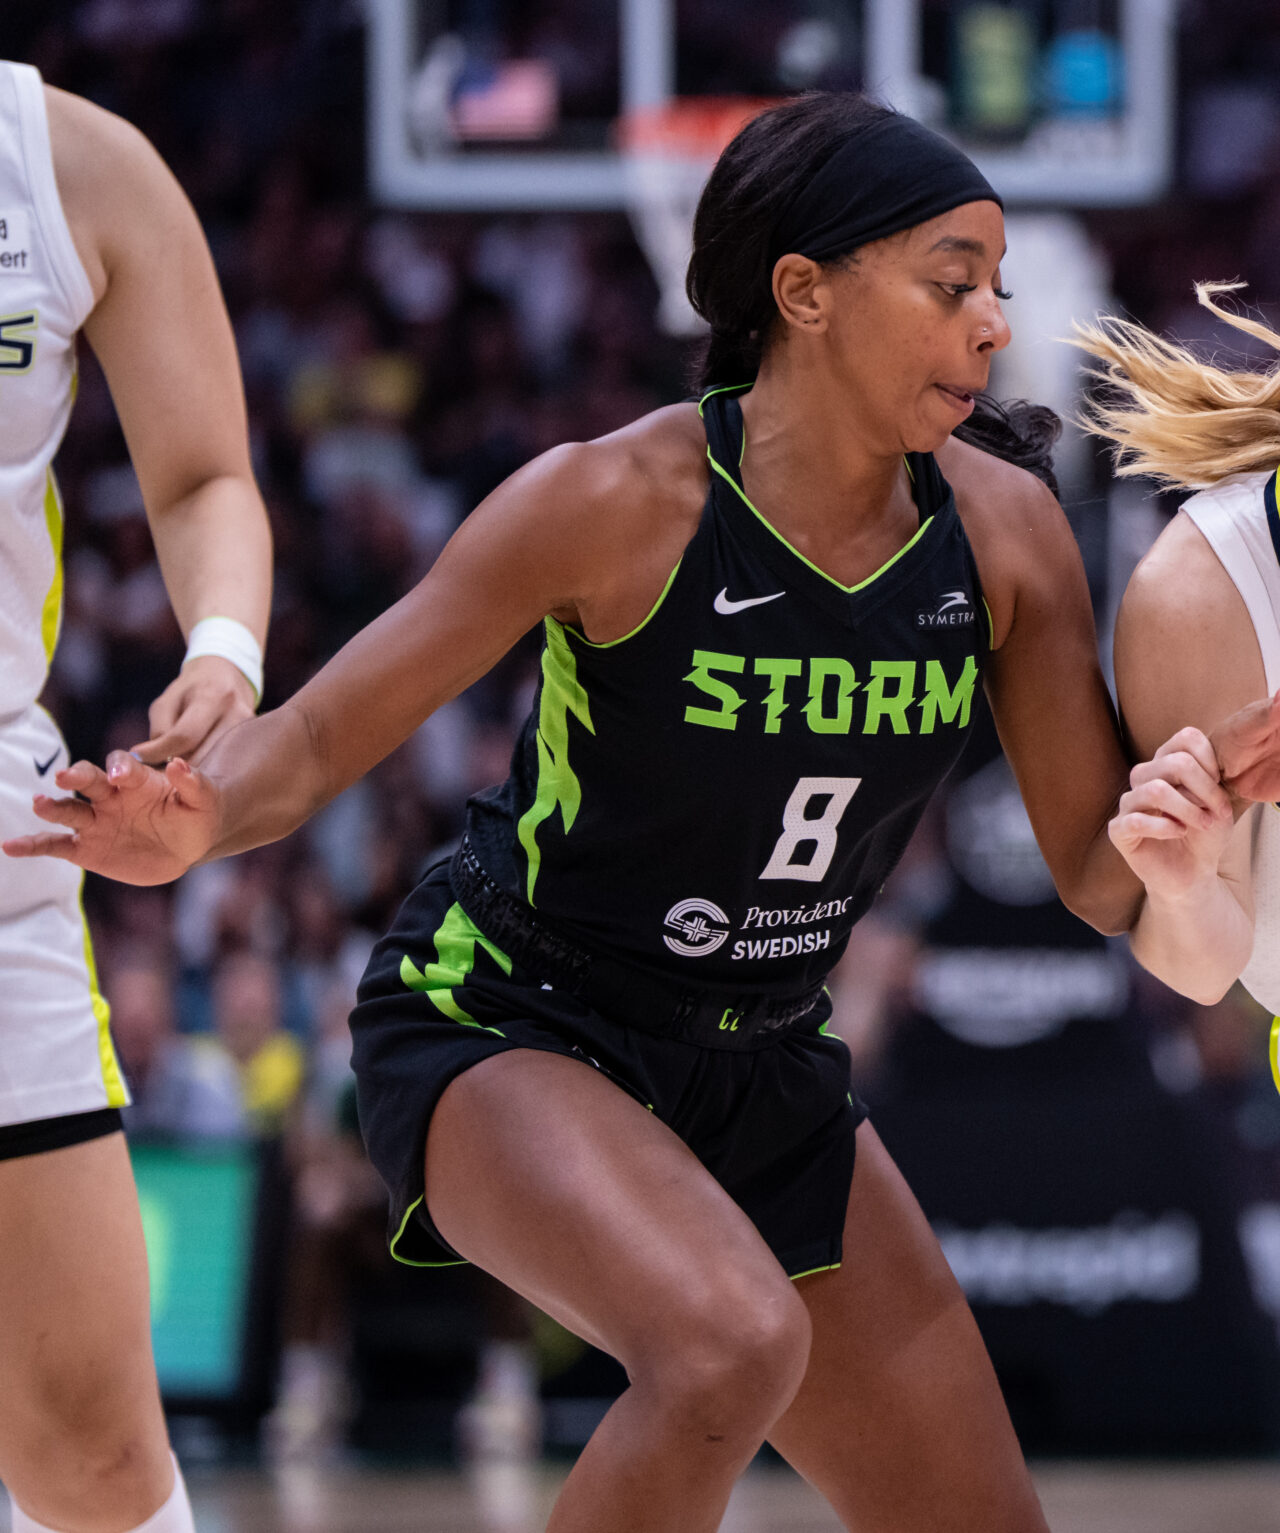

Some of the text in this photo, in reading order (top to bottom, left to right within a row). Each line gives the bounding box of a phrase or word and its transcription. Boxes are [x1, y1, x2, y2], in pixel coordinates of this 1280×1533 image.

[918, 611, 975, 625] SYMETRA
[682, 649, 979, 735] STORM
[758, 777, 863, 882] 8
[740, 896, 853, 930] Providenc
[731, 930, 830, 960] SWEDISH
